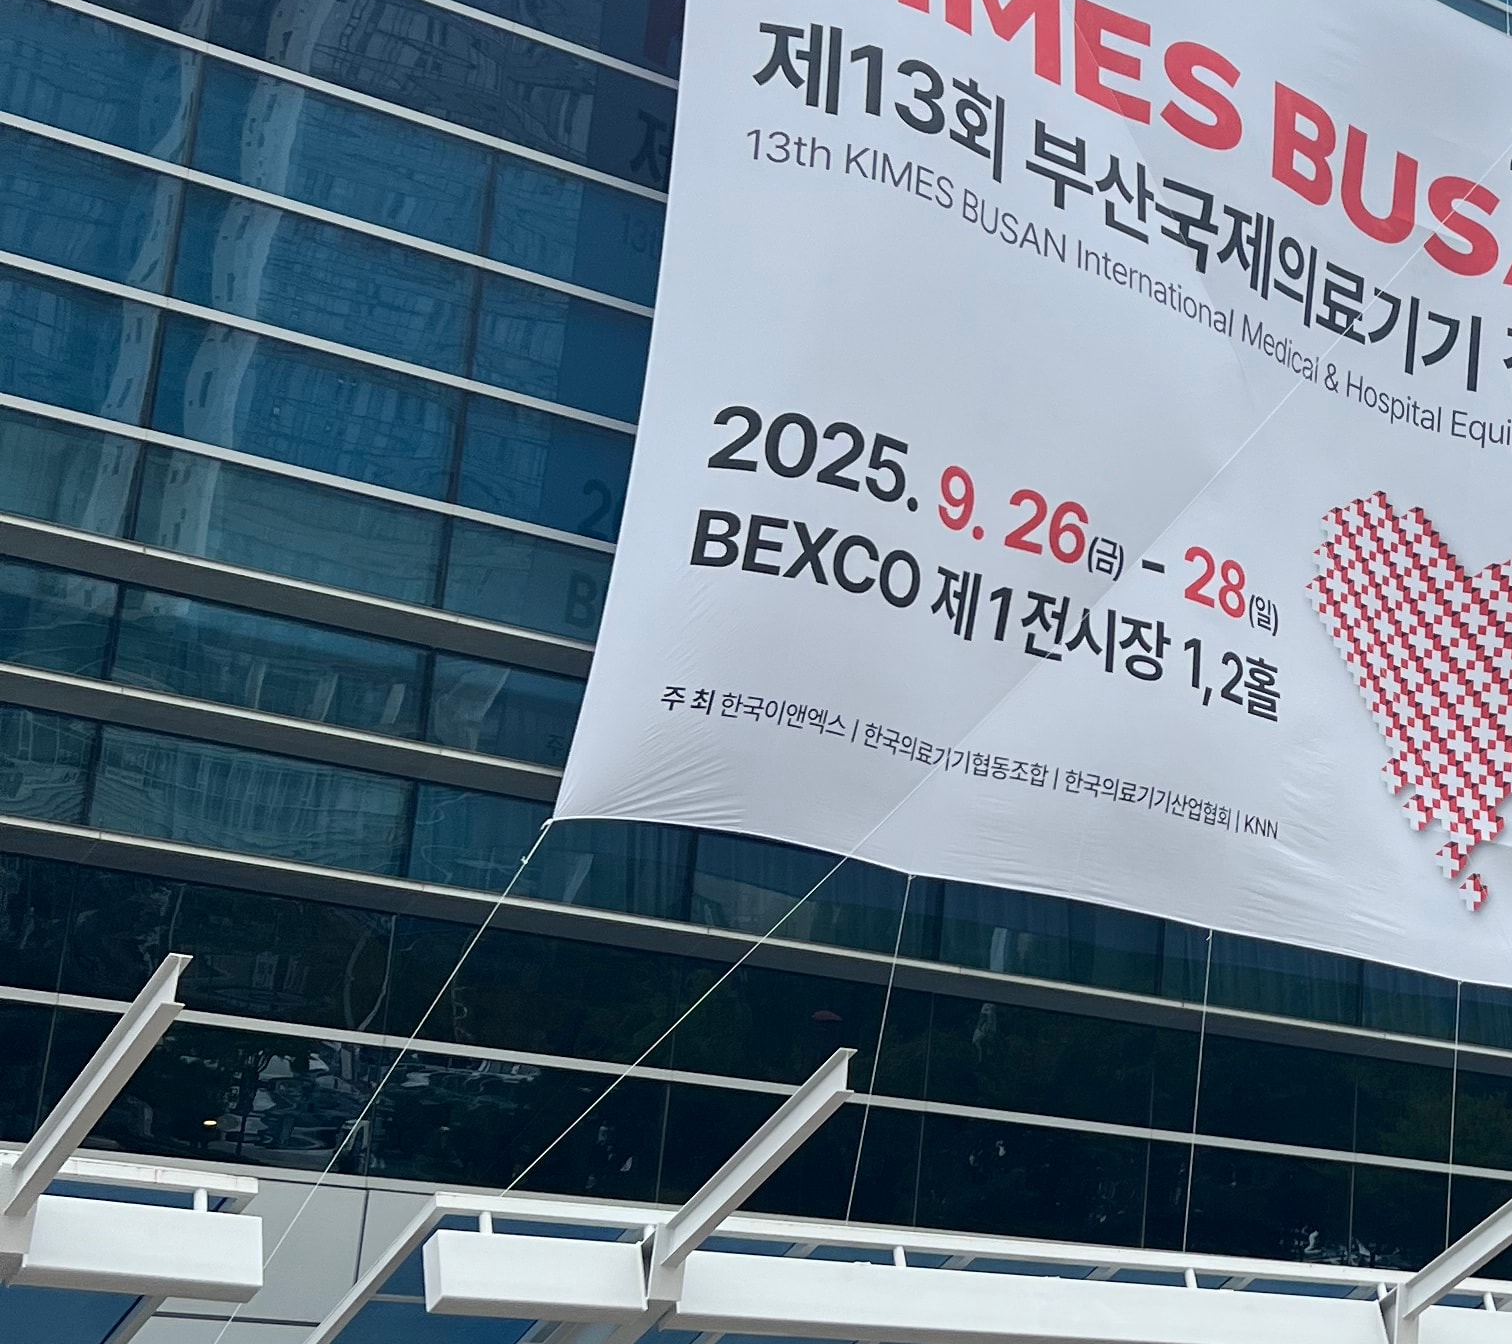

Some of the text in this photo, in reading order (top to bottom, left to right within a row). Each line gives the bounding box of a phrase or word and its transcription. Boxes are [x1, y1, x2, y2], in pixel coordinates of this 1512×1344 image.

[746, 129, 831, 170] 13th
[845, 143, 954, 210] KIMES
[962, 188, 1067, 263] BUSAN
[1077, 239, 1234, 338] International
[1241, 313, 1319, 384] Medical
[1324, 362, 1339, 393] &
[1346, 375, 1442, 433] Hospital
[752, 22, 1006, 184] 제13회
[1025, 119, 1482, 393] 부산국제의료기기
[707, 405, 919, 512] 2025.
[690, 508, 921, 609] BEXCO
[722, 690, 846, 738] 한국이앤엑스
[863, 722, 1049, 787] 한국의료기기협동조합
[1064, 769, 1232, 832] 한국의료기기산업협회
[1243, 813, 1279, 840] KNN
